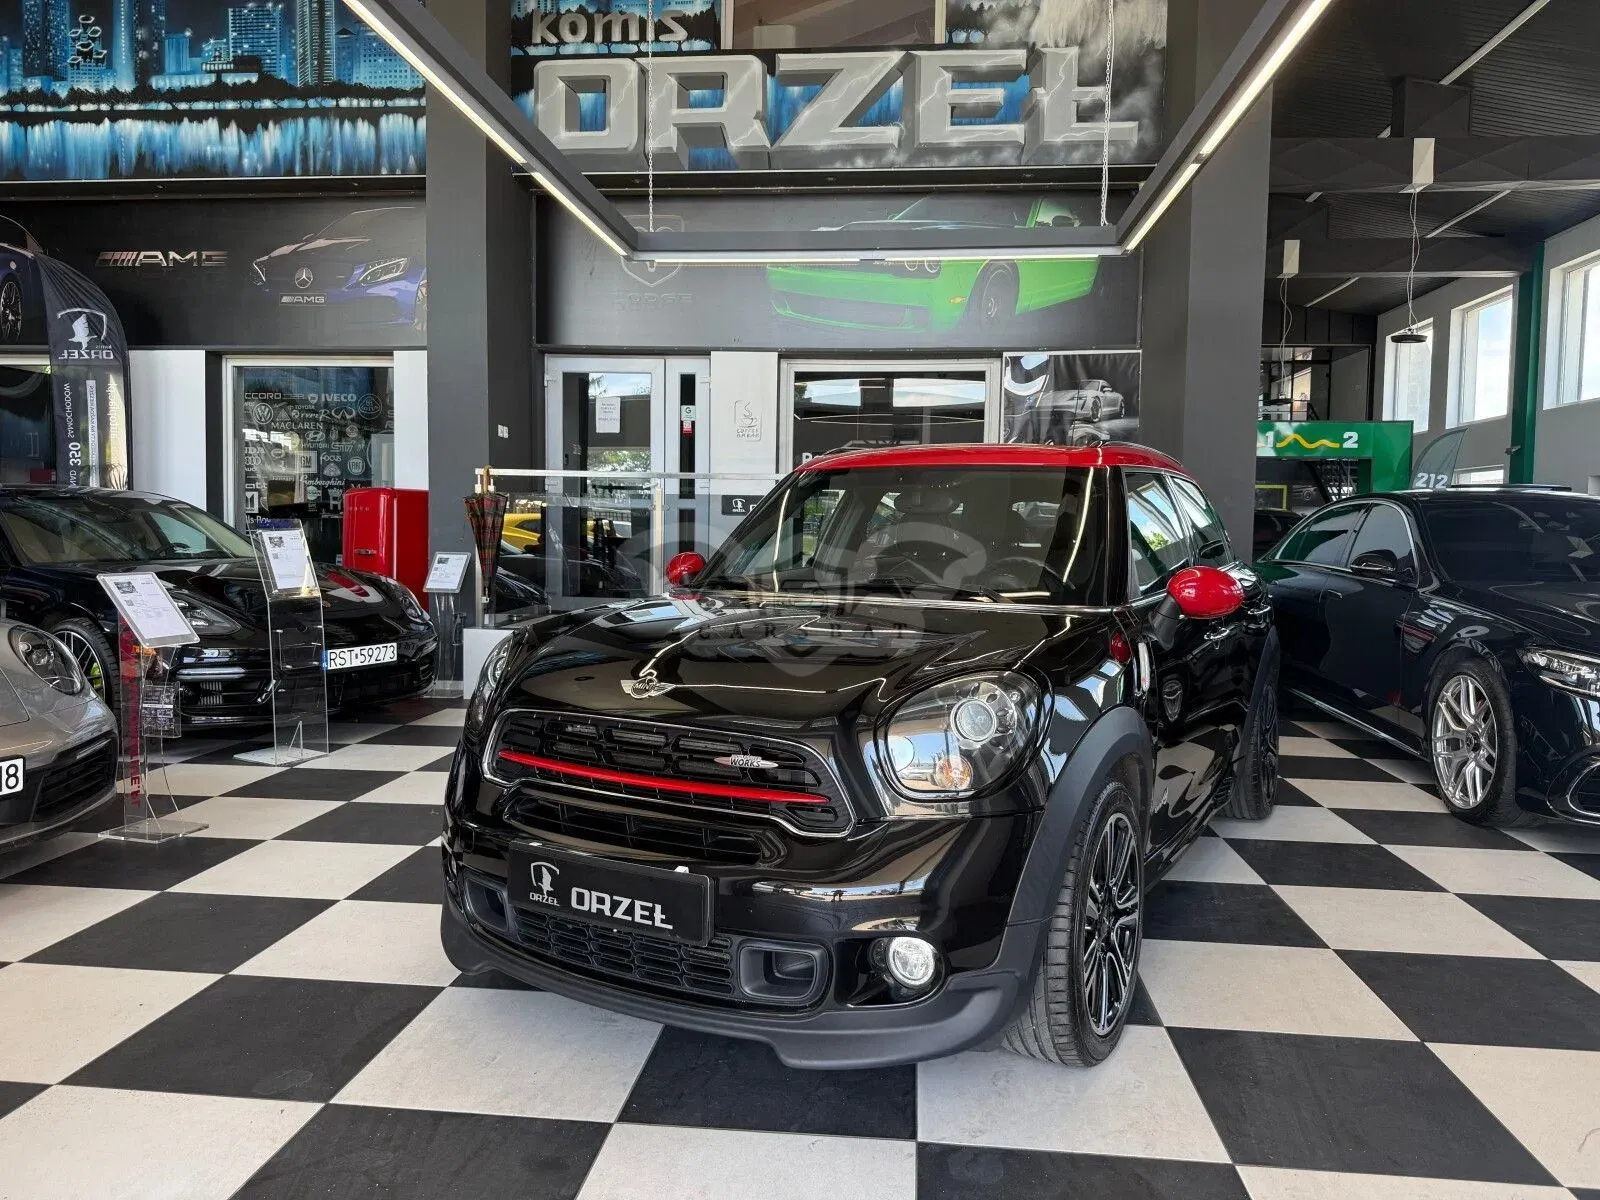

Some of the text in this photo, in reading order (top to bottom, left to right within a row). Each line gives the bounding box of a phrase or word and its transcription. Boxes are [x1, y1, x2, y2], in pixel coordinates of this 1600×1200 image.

[532, 8, 688, 43] komis
[534, 47, 1138, 154] ORZEŁ
[135, 250, 228, 267] AMG
[294, 296, 326, 304] AMG
[321, 393, 357, 402] IVECO
[271, 421, 324, 430] MACLAREN
[1342, 431, 1359, 449] 2
[1415, 472, 1449, 489] 212
[329, 644, 396, 668] RST 59273
[730, 758, 761, 768] WORKS
[0, 763, 20, 793] 8
[529, 891, 561, 907] ORZEŁ
[570, 886, 673, 930] ORZEŁ
